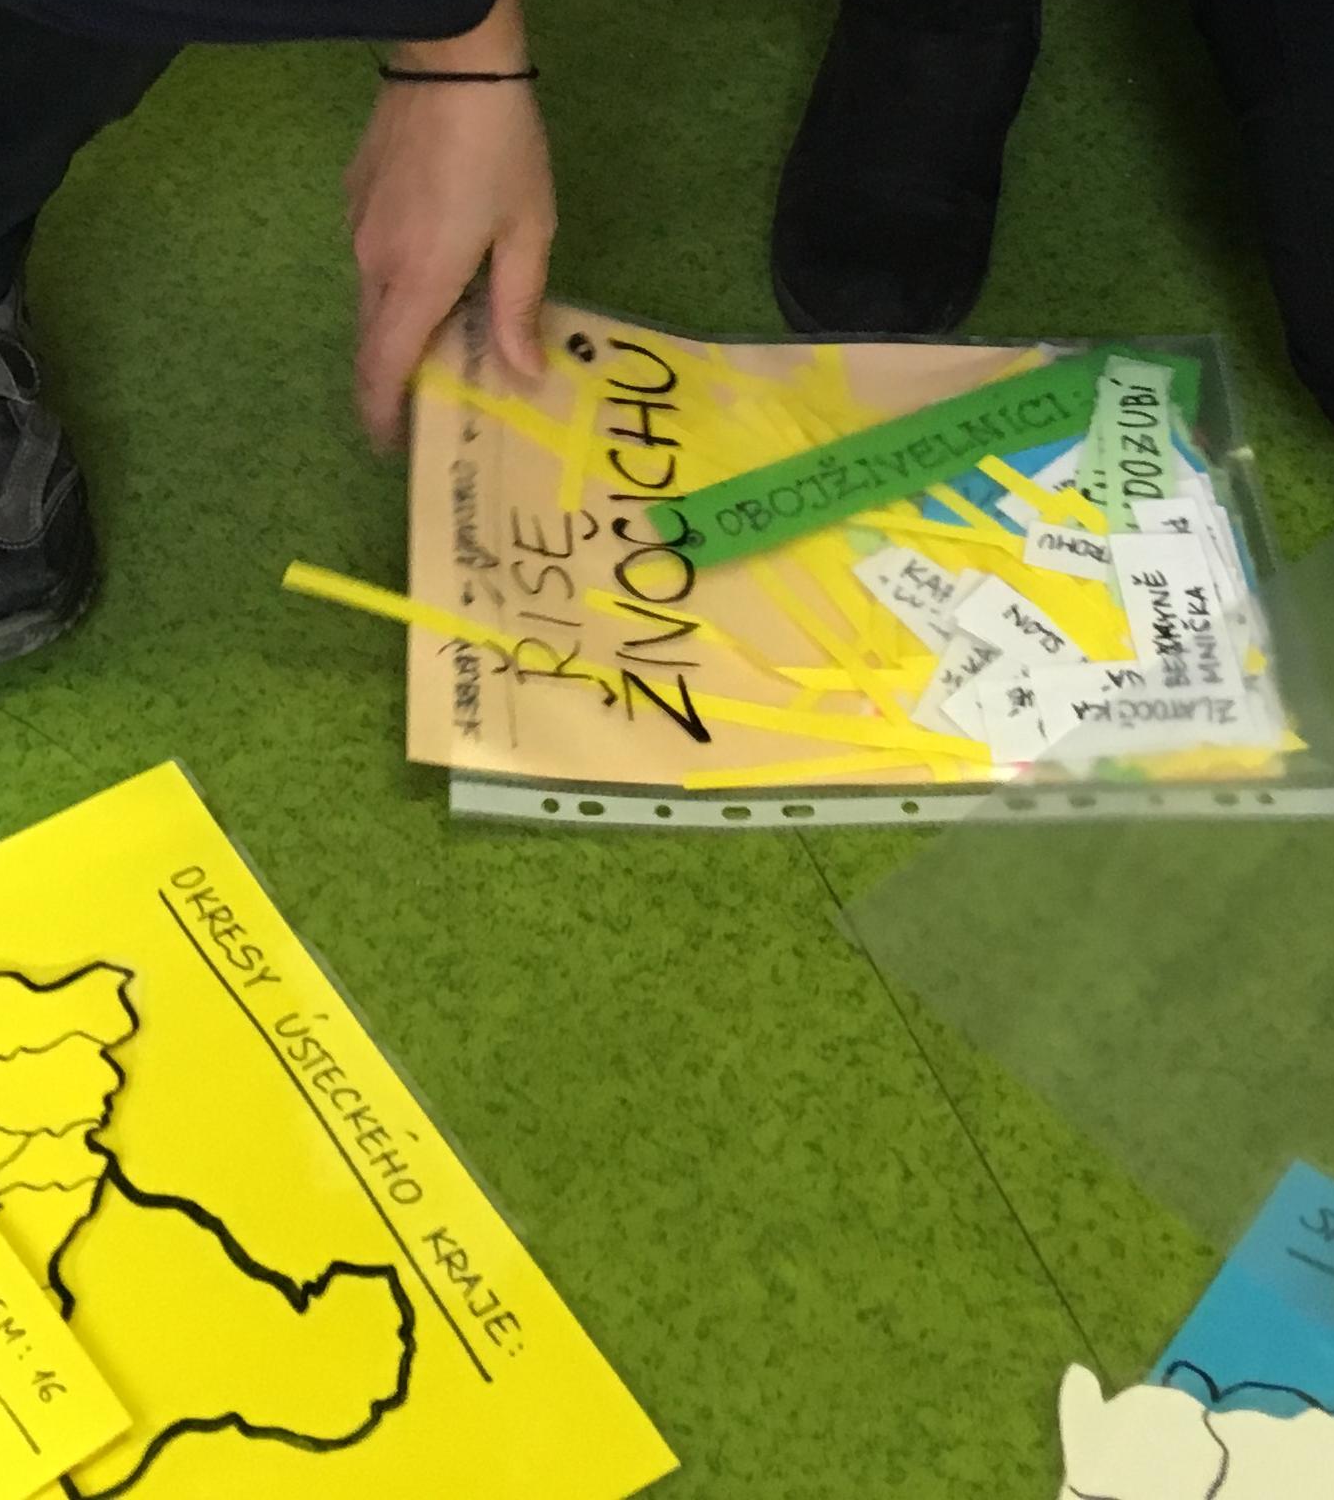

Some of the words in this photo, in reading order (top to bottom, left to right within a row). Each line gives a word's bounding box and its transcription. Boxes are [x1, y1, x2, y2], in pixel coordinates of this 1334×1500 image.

[565, 331, 712, 743] ŽIVOČICHŮ
[1109, 377, 1165, 531] DOZUBÍ
[169, 864, 282, 991] OKRESY
[273, 1012, 425, 1206] ÚSTECKÉHO
[420, 1225, 525, 1358] KRAJE:
[30, 1369, 68, 1404] 16
